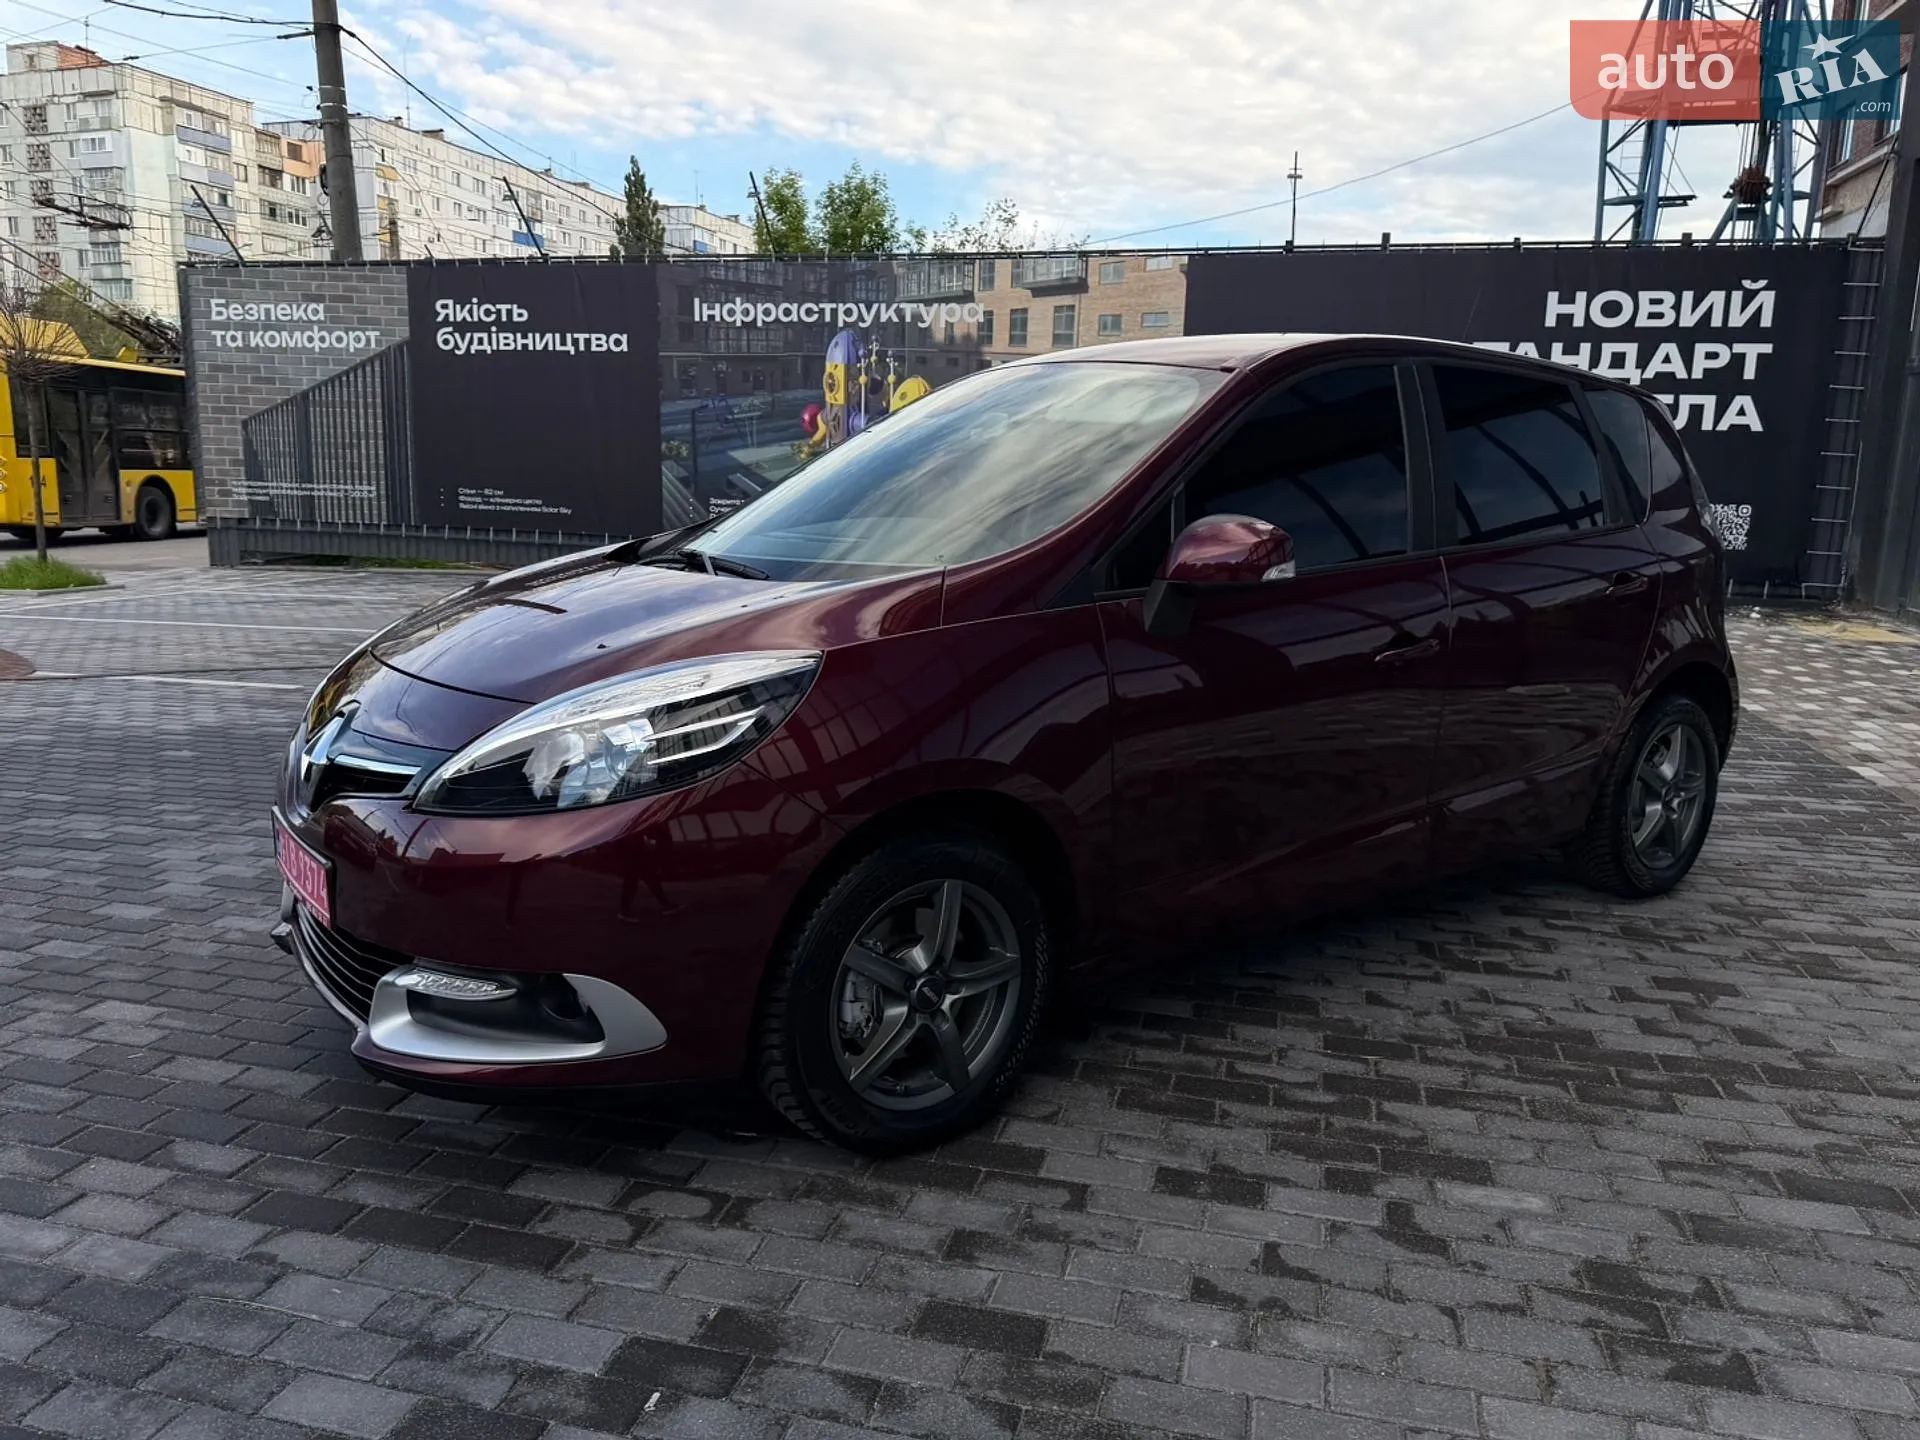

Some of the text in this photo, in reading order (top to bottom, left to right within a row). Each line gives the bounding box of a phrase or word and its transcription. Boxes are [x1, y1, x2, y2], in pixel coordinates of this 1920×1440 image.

[210, 298, 325, 321] Безпека
[434, 297, 529, 323] Якість
[693, 297, 985, 328] Інфраструктура
[1544, 279, 1776, 329] НОВИЙ
[211, 327, 381, 352] та комфорт
[436, 325, 628, 355] будівництва
